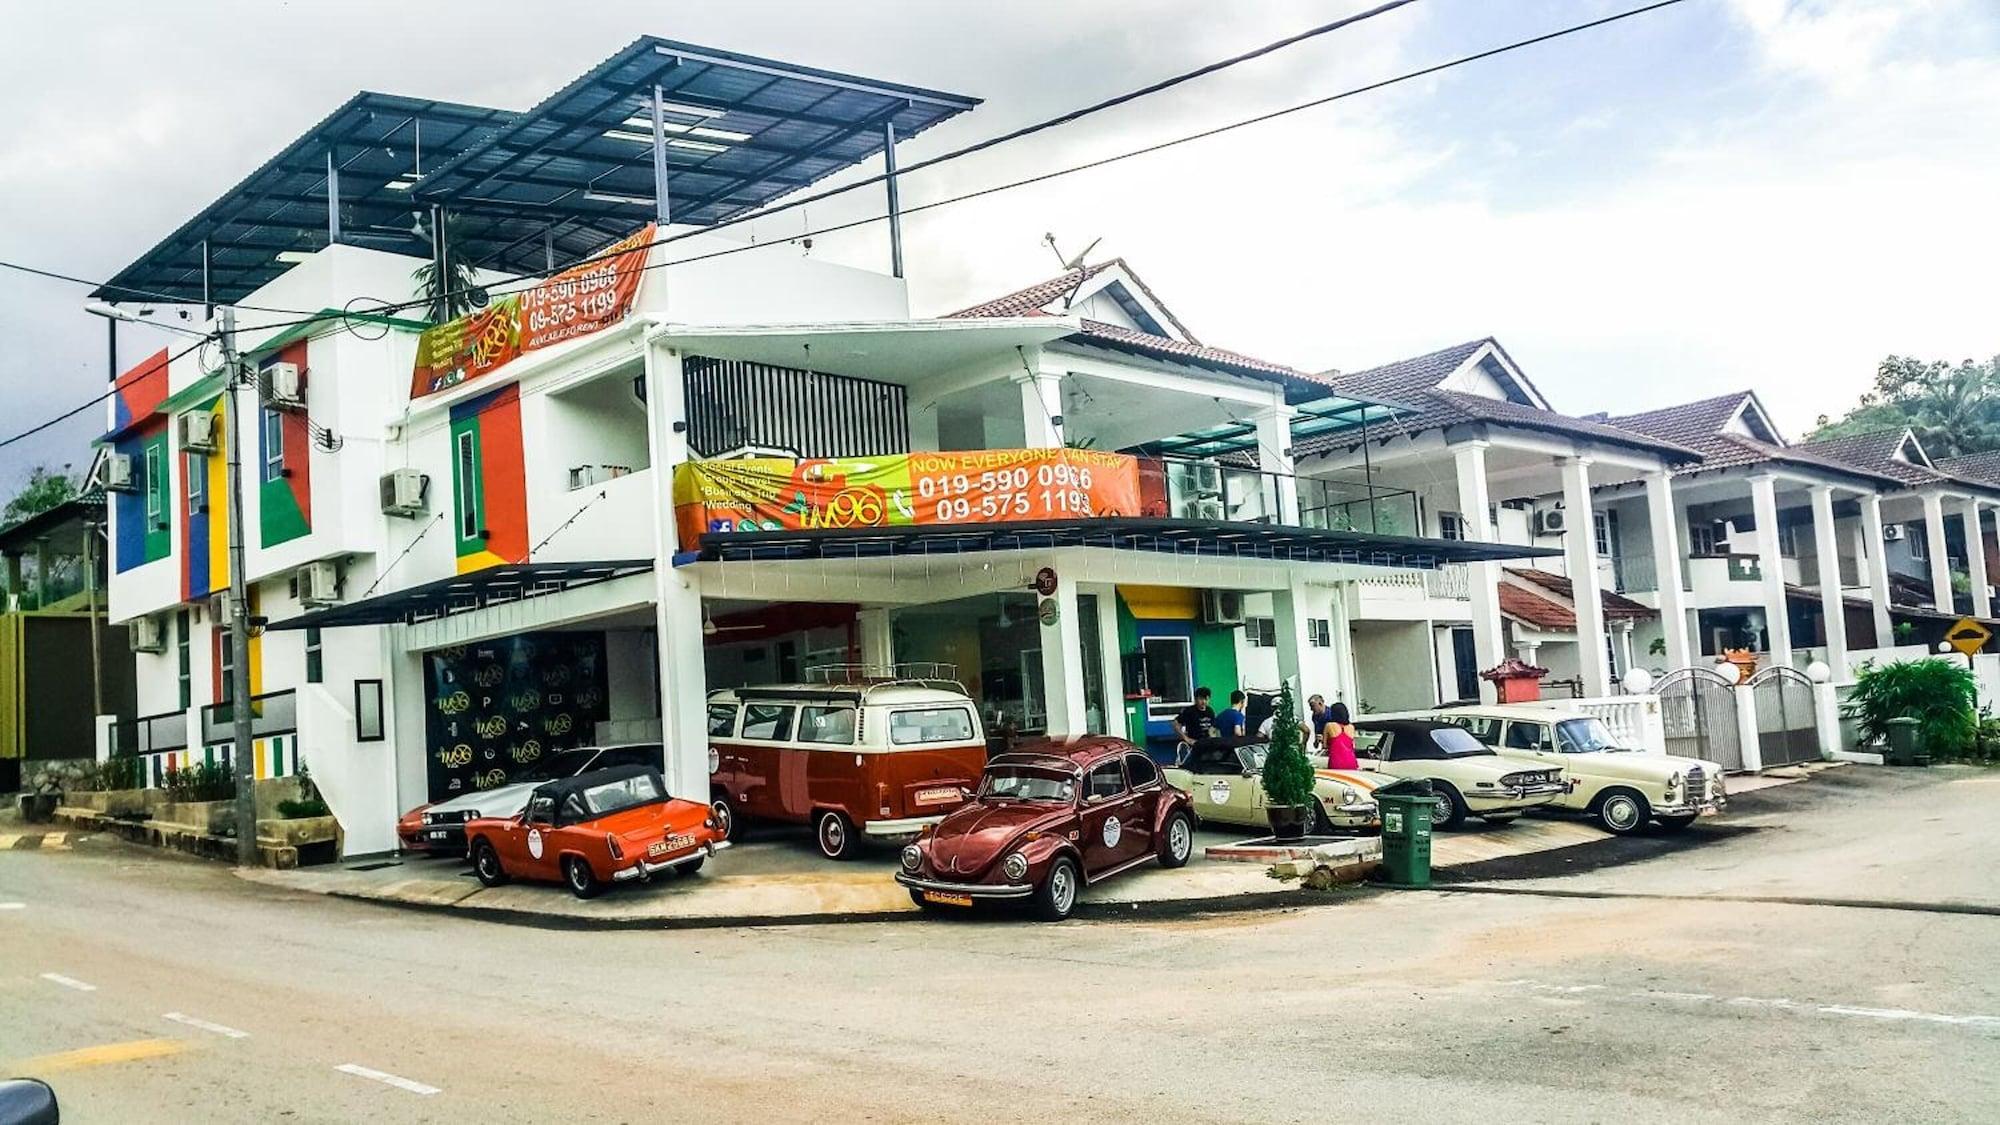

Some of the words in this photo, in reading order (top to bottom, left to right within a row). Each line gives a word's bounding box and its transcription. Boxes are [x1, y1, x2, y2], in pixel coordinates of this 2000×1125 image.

[529, 301, 577, 332] 09-575
[581, 289, 617, 318] 1199
[737, 463, 774, 475] Events
[912, 456, 956, 474] NOW
[962, 447, 1057, 470] EVERYONE
[1093, 453, 1121, 469] STAY
[740, 475, 771, 487] Travel
[919, 466, 1029, 498] 019-590
[1038, 463, 1092, 490] 0966
[705, 500, 752, 513] Wedding
[936, 491, 1031, 521] 09-575
